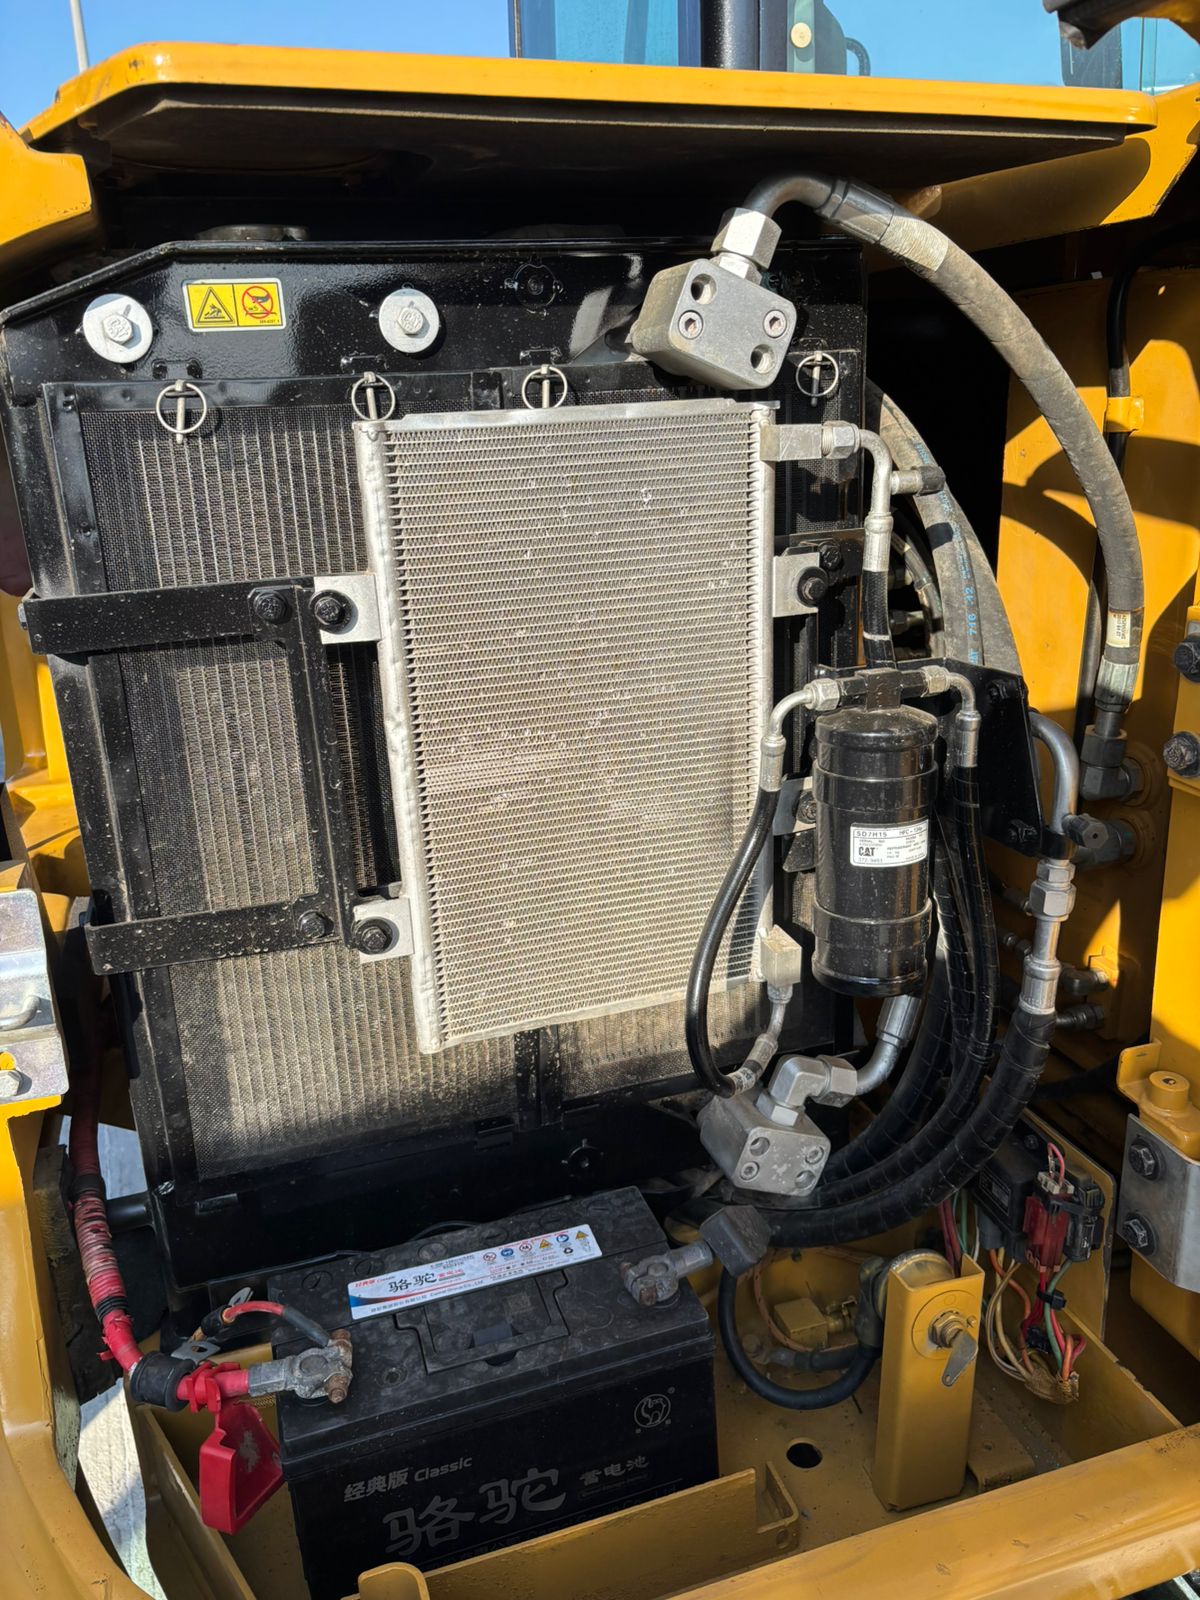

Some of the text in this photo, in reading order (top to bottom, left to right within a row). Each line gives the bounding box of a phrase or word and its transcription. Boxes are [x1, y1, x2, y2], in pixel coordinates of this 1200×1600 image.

[858, 846, 875, 857] CAT
[388, 1272, 438, 1293] 骆驼
[343, 1456, 473, 1502] 经典版 Classic
[382, 1466, 567, 1556] 骆驼
[578, 1455, 649, 1486] 蓄电池
